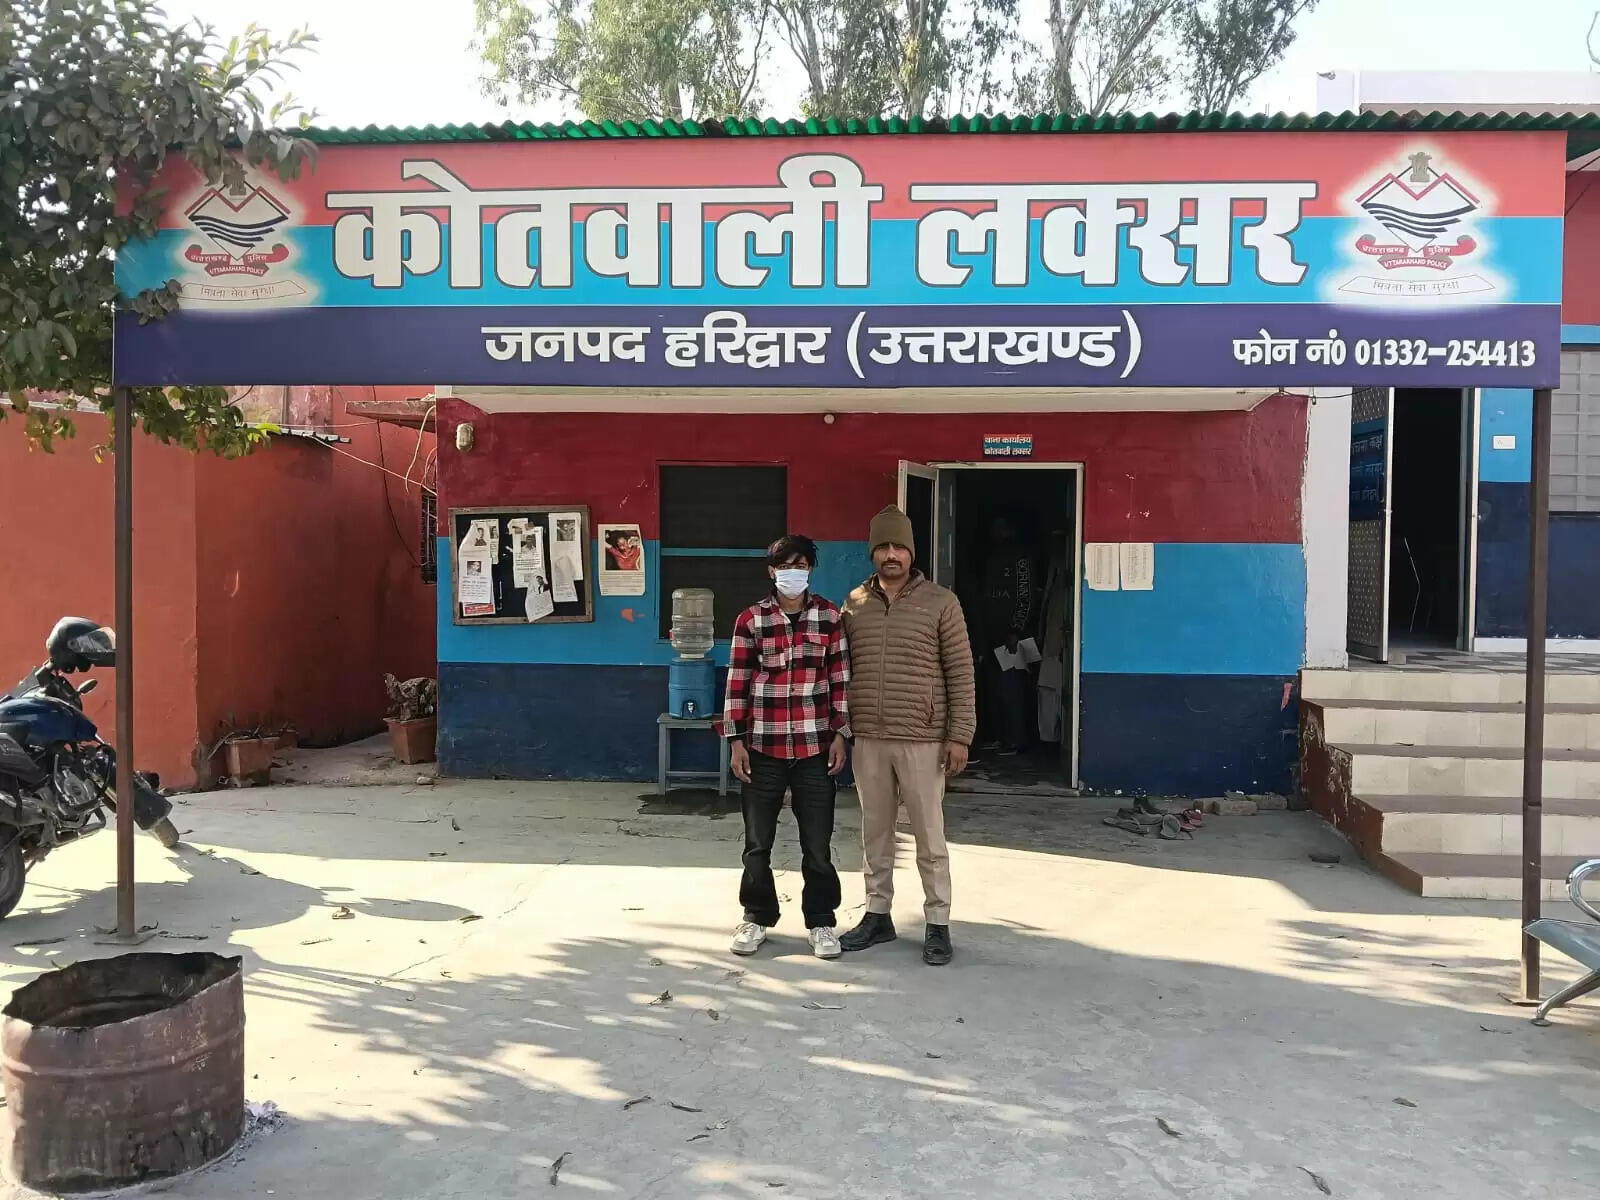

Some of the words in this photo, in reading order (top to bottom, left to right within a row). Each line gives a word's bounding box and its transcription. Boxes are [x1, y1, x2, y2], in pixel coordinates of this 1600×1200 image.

[326, 153, 883, 289] कोतवाली
[910, 180, 1318, 288] लक्सर
[481, 326, 651, 362] जनपद
[663, 310, 831, 369] हरिद्वार
[846, 310, 1142, 379] (उत्तराखण्ड)
[1233, 328, 1299, 366] फोन
[1354, 338, 1536, 367] 01332-254413
